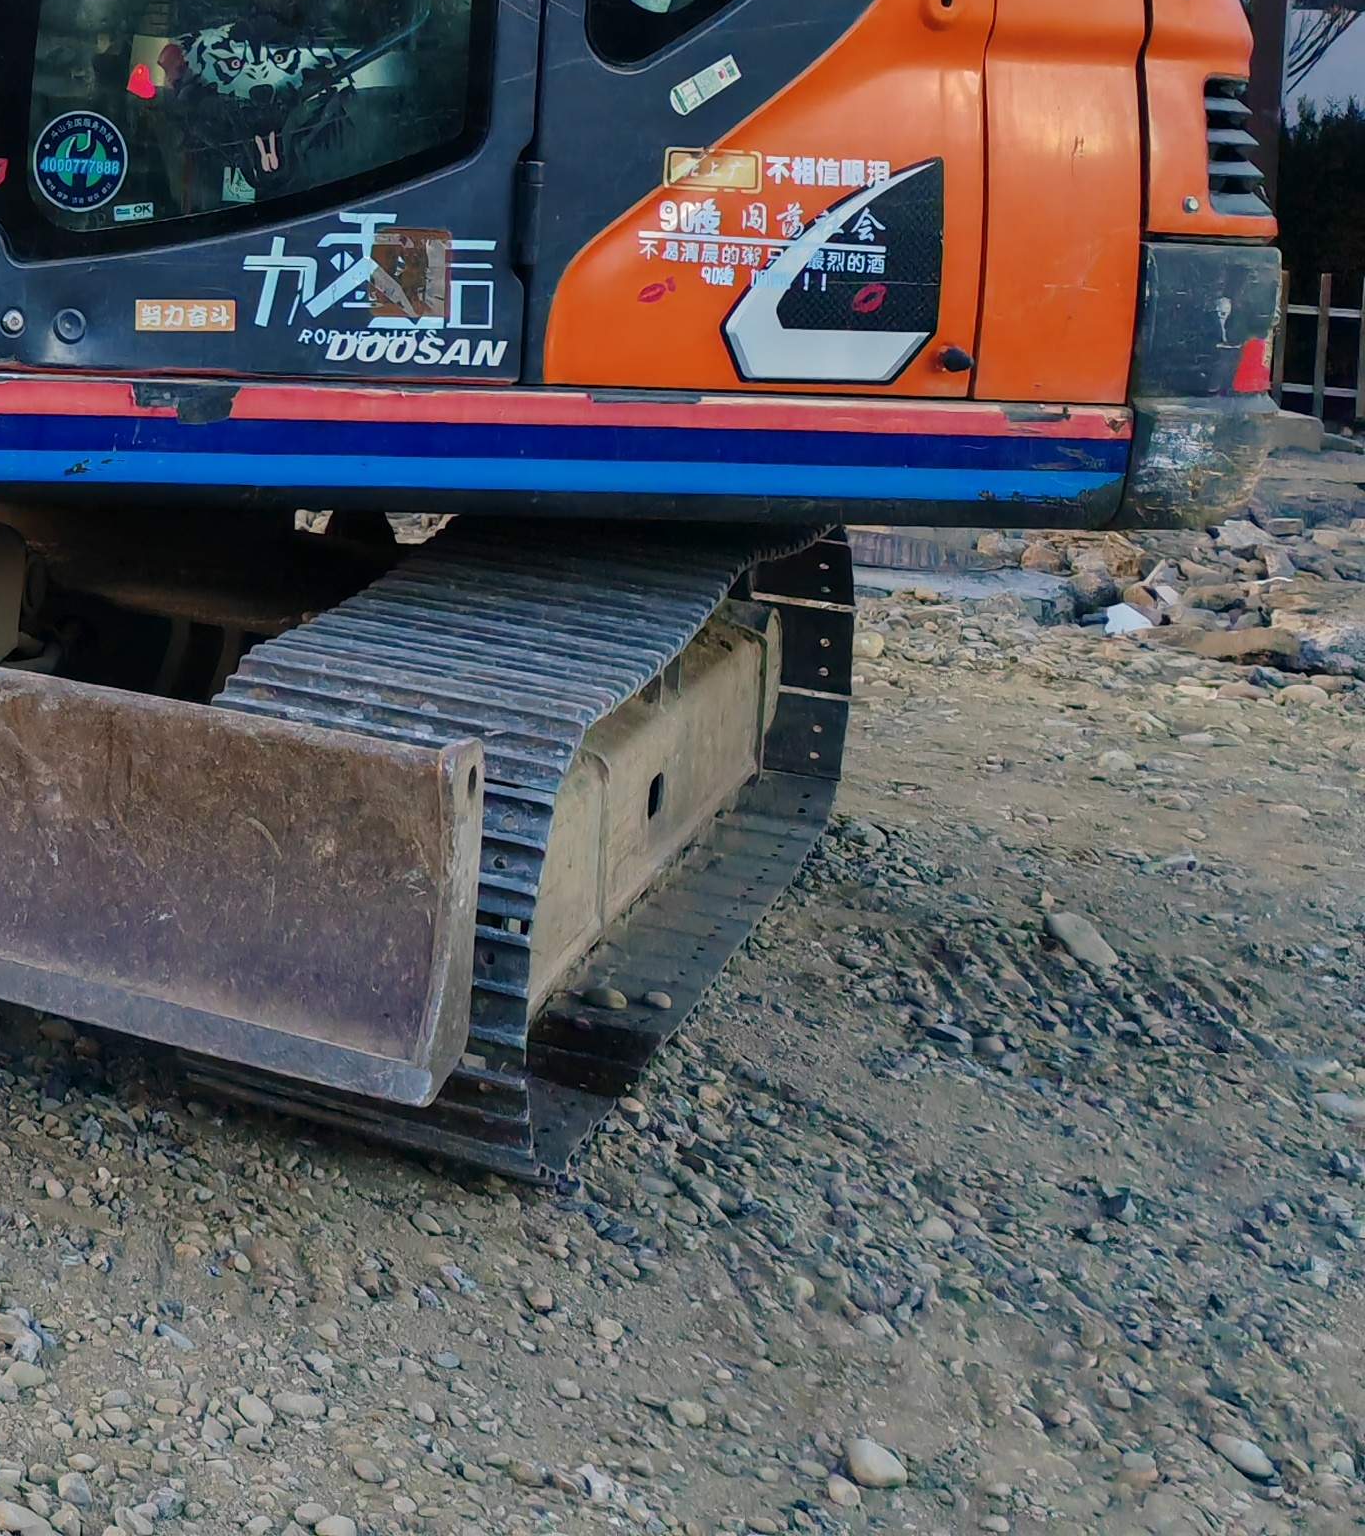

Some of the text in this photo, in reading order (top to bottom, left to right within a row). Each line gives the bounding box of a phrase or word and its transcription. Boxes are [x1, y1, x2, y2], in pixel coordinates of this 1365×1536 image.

[765, 155, 892, 188] 不相信眼泪
[140, 304, 232, 329] 努力奋斗
[324, 334, 509, 367] DOOSAN
